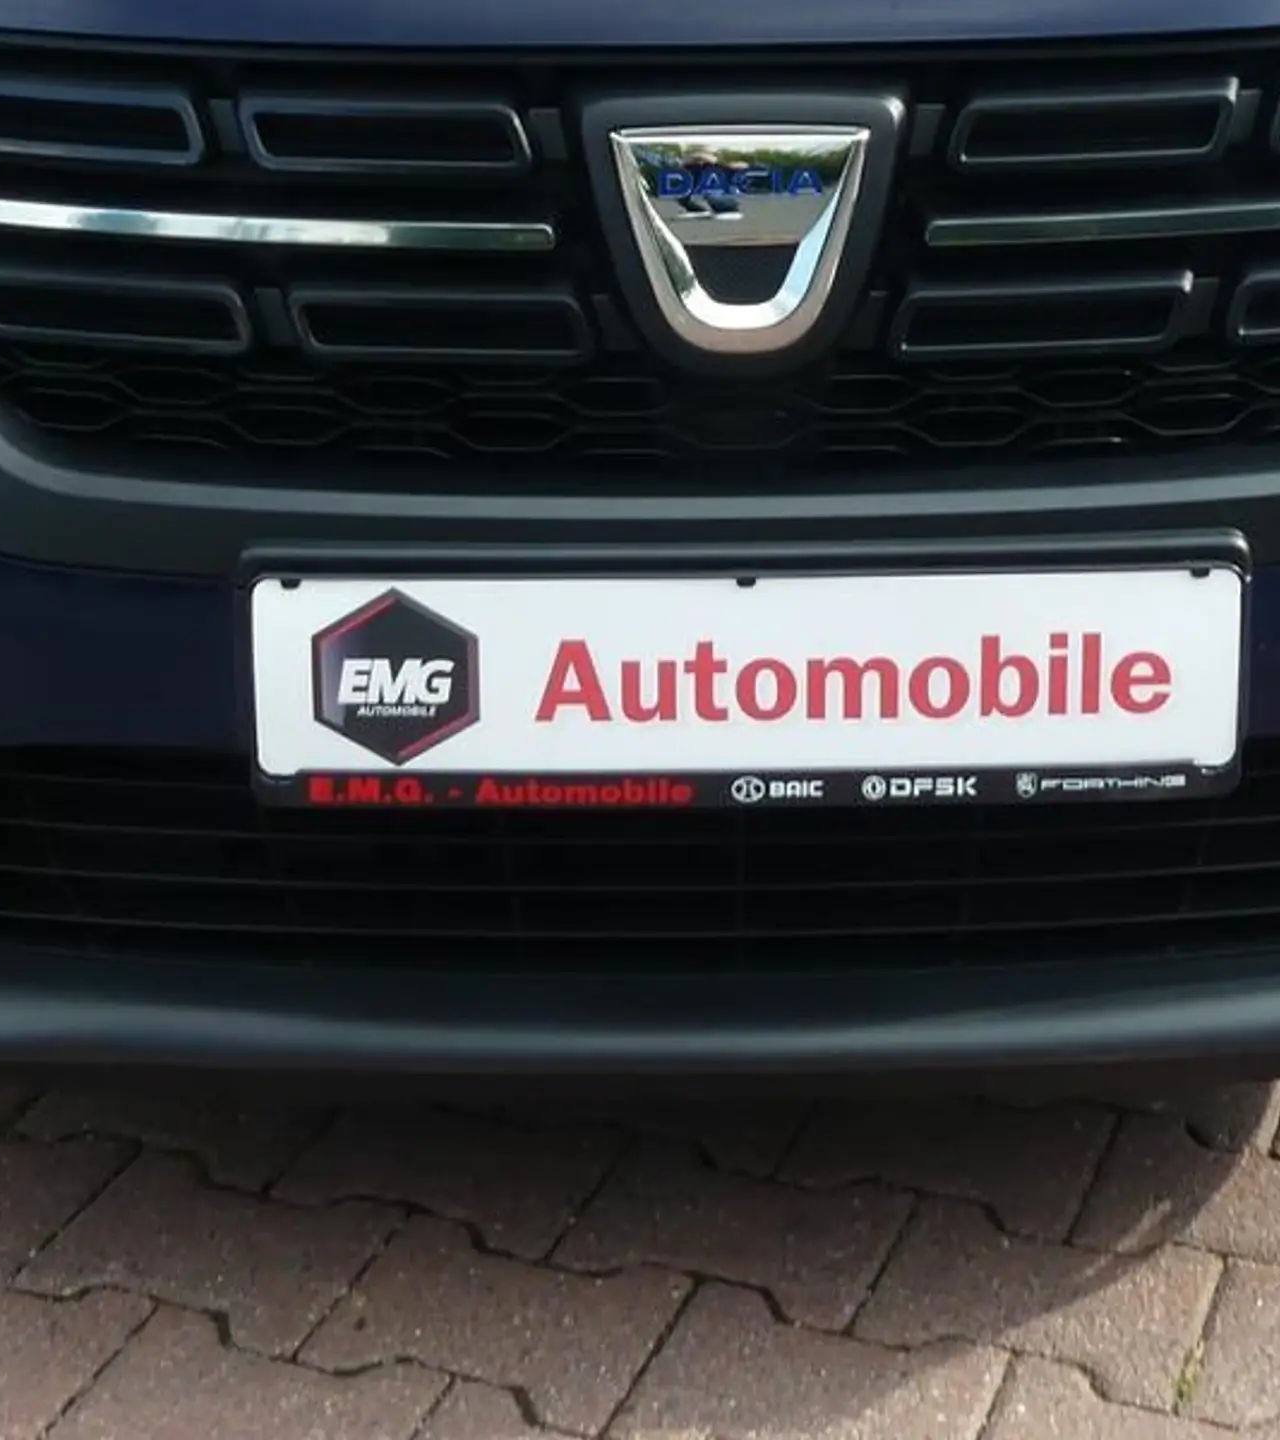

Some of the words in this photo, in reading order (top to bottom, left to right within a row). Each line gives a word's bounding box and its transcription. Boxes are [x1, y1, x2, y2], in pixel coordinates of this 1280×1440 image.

[658, 168, 823, 195] DACIA
[337, 658, 455, 705] EMG
[534, 633, 1172, 722] Automobile
[356, 705, 437, 717] AUTOMOBILE
[308, 777, 433, 804] E.M.G.
[475, 776, 694, 805] Automobile
[769, 779, 824, 798] BAIC
[889, 776, 977, 797] DFSK
